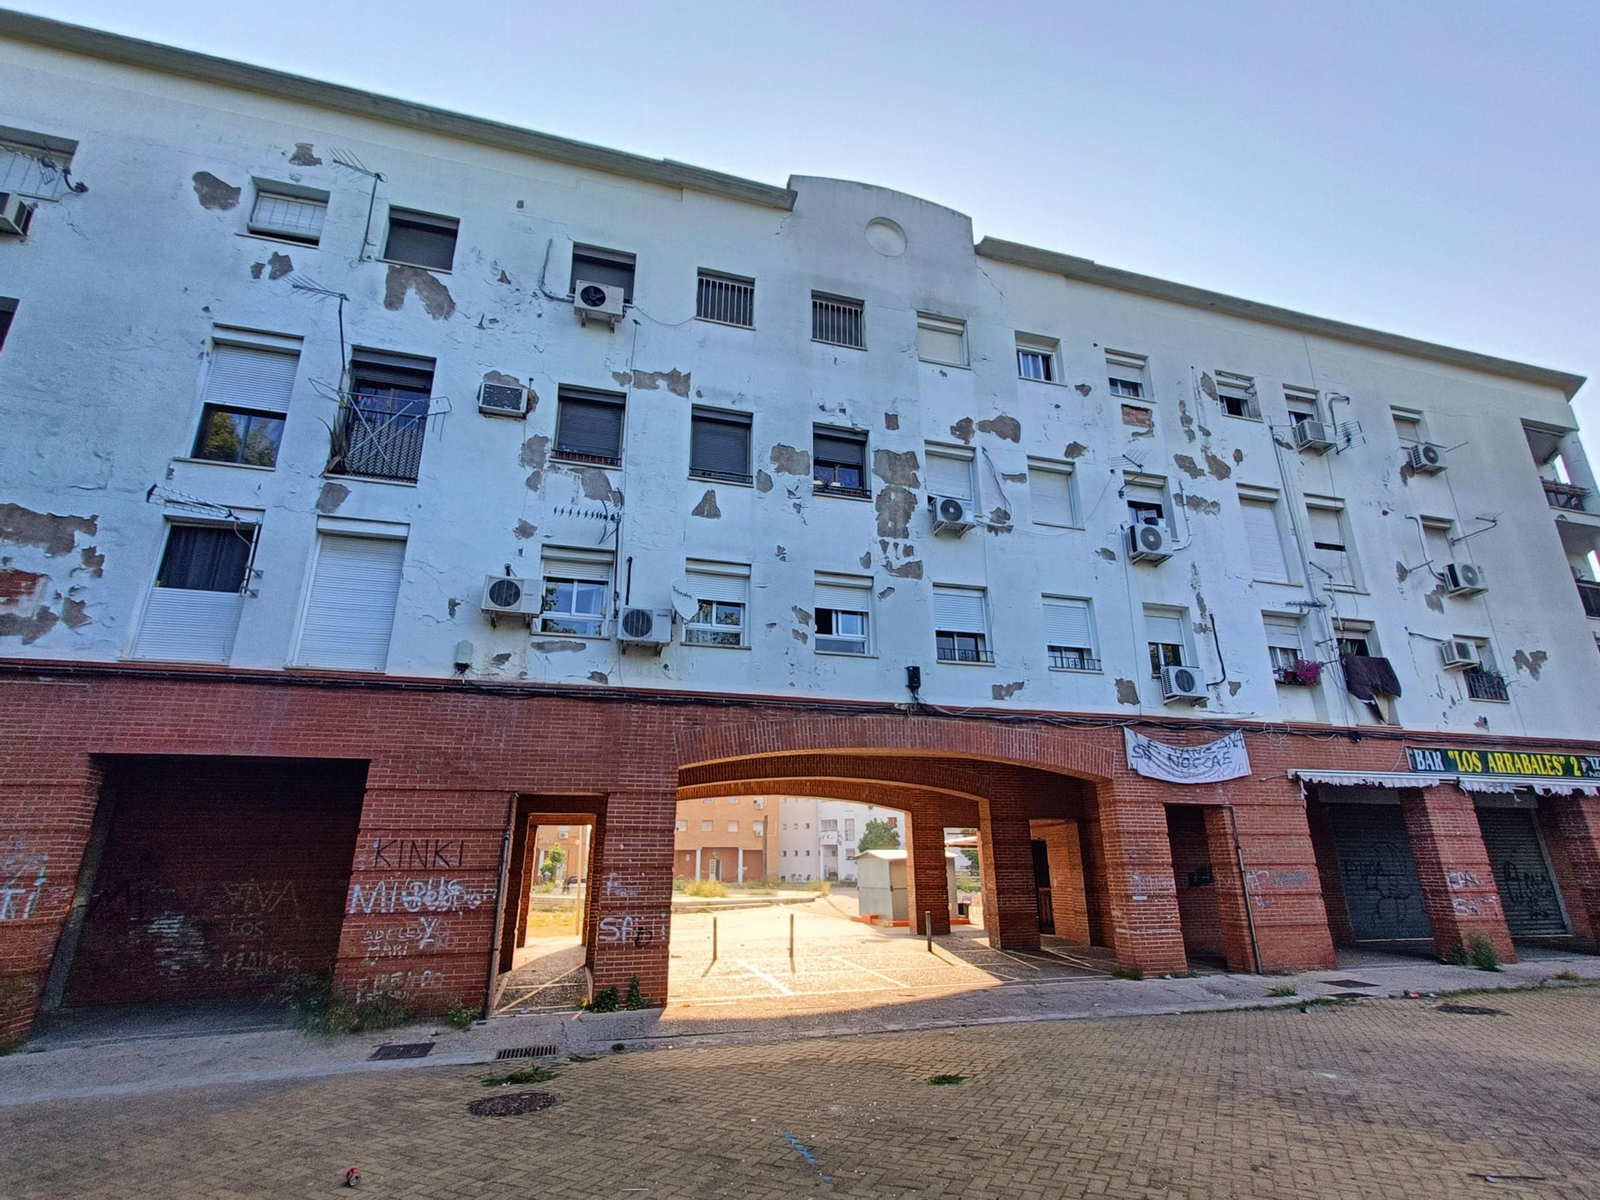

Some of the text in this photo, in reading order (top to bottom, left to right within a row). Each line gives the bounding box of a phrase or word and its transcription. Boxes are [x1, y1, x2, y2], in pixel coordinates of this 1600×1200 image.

[1413, 749, 1582, 777] BAR "LOS ARRABALES" 2
[374, 838, 464, 869] KINKI
